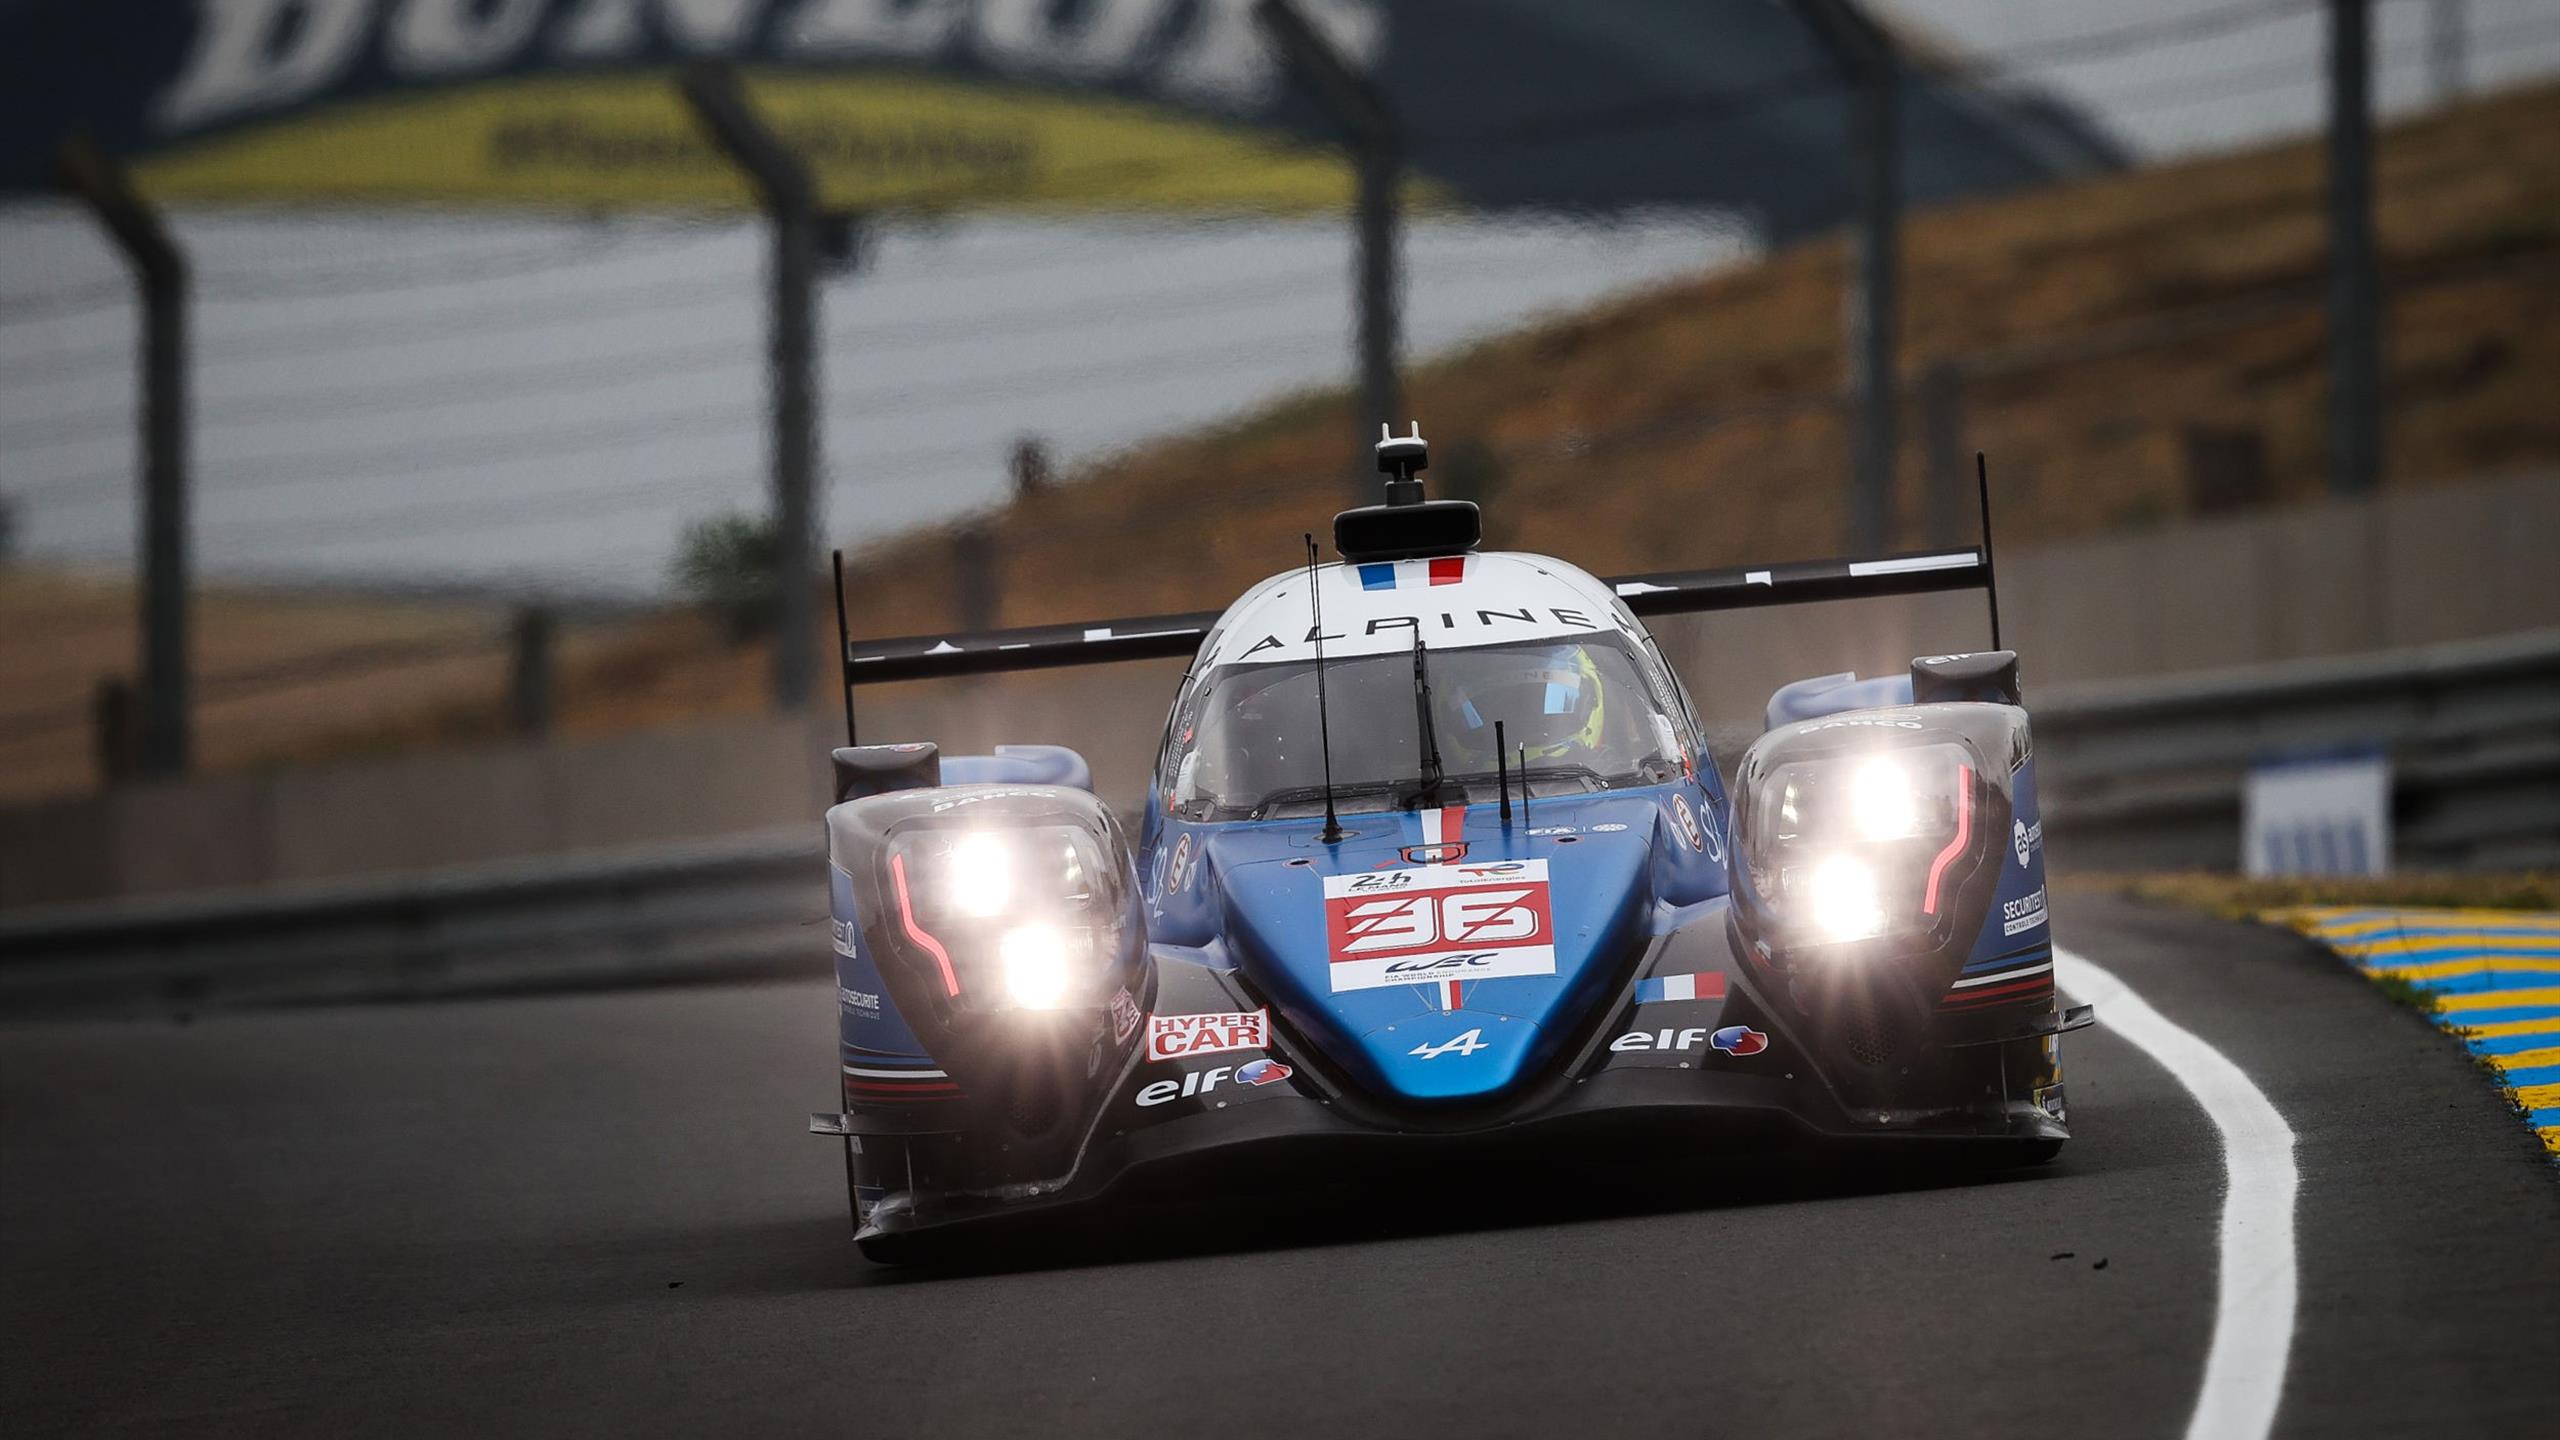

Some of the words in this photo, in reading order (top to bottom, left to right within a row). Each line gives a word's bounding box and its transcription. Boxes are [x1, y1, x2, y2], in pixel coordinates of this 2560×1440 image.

[1238, 607, 1598, 661] ALPINE
[1341, 889, 1540, 953] 36
[1385, 953, 1499, 974] WEC
[1154, 1014, 1261, 1033] HYPER
[1154, 1026, 1261, 1056] CAR
[1609, 1028, 1707, 1051] elf
[1135, 1066, 1232, 1107] elf
